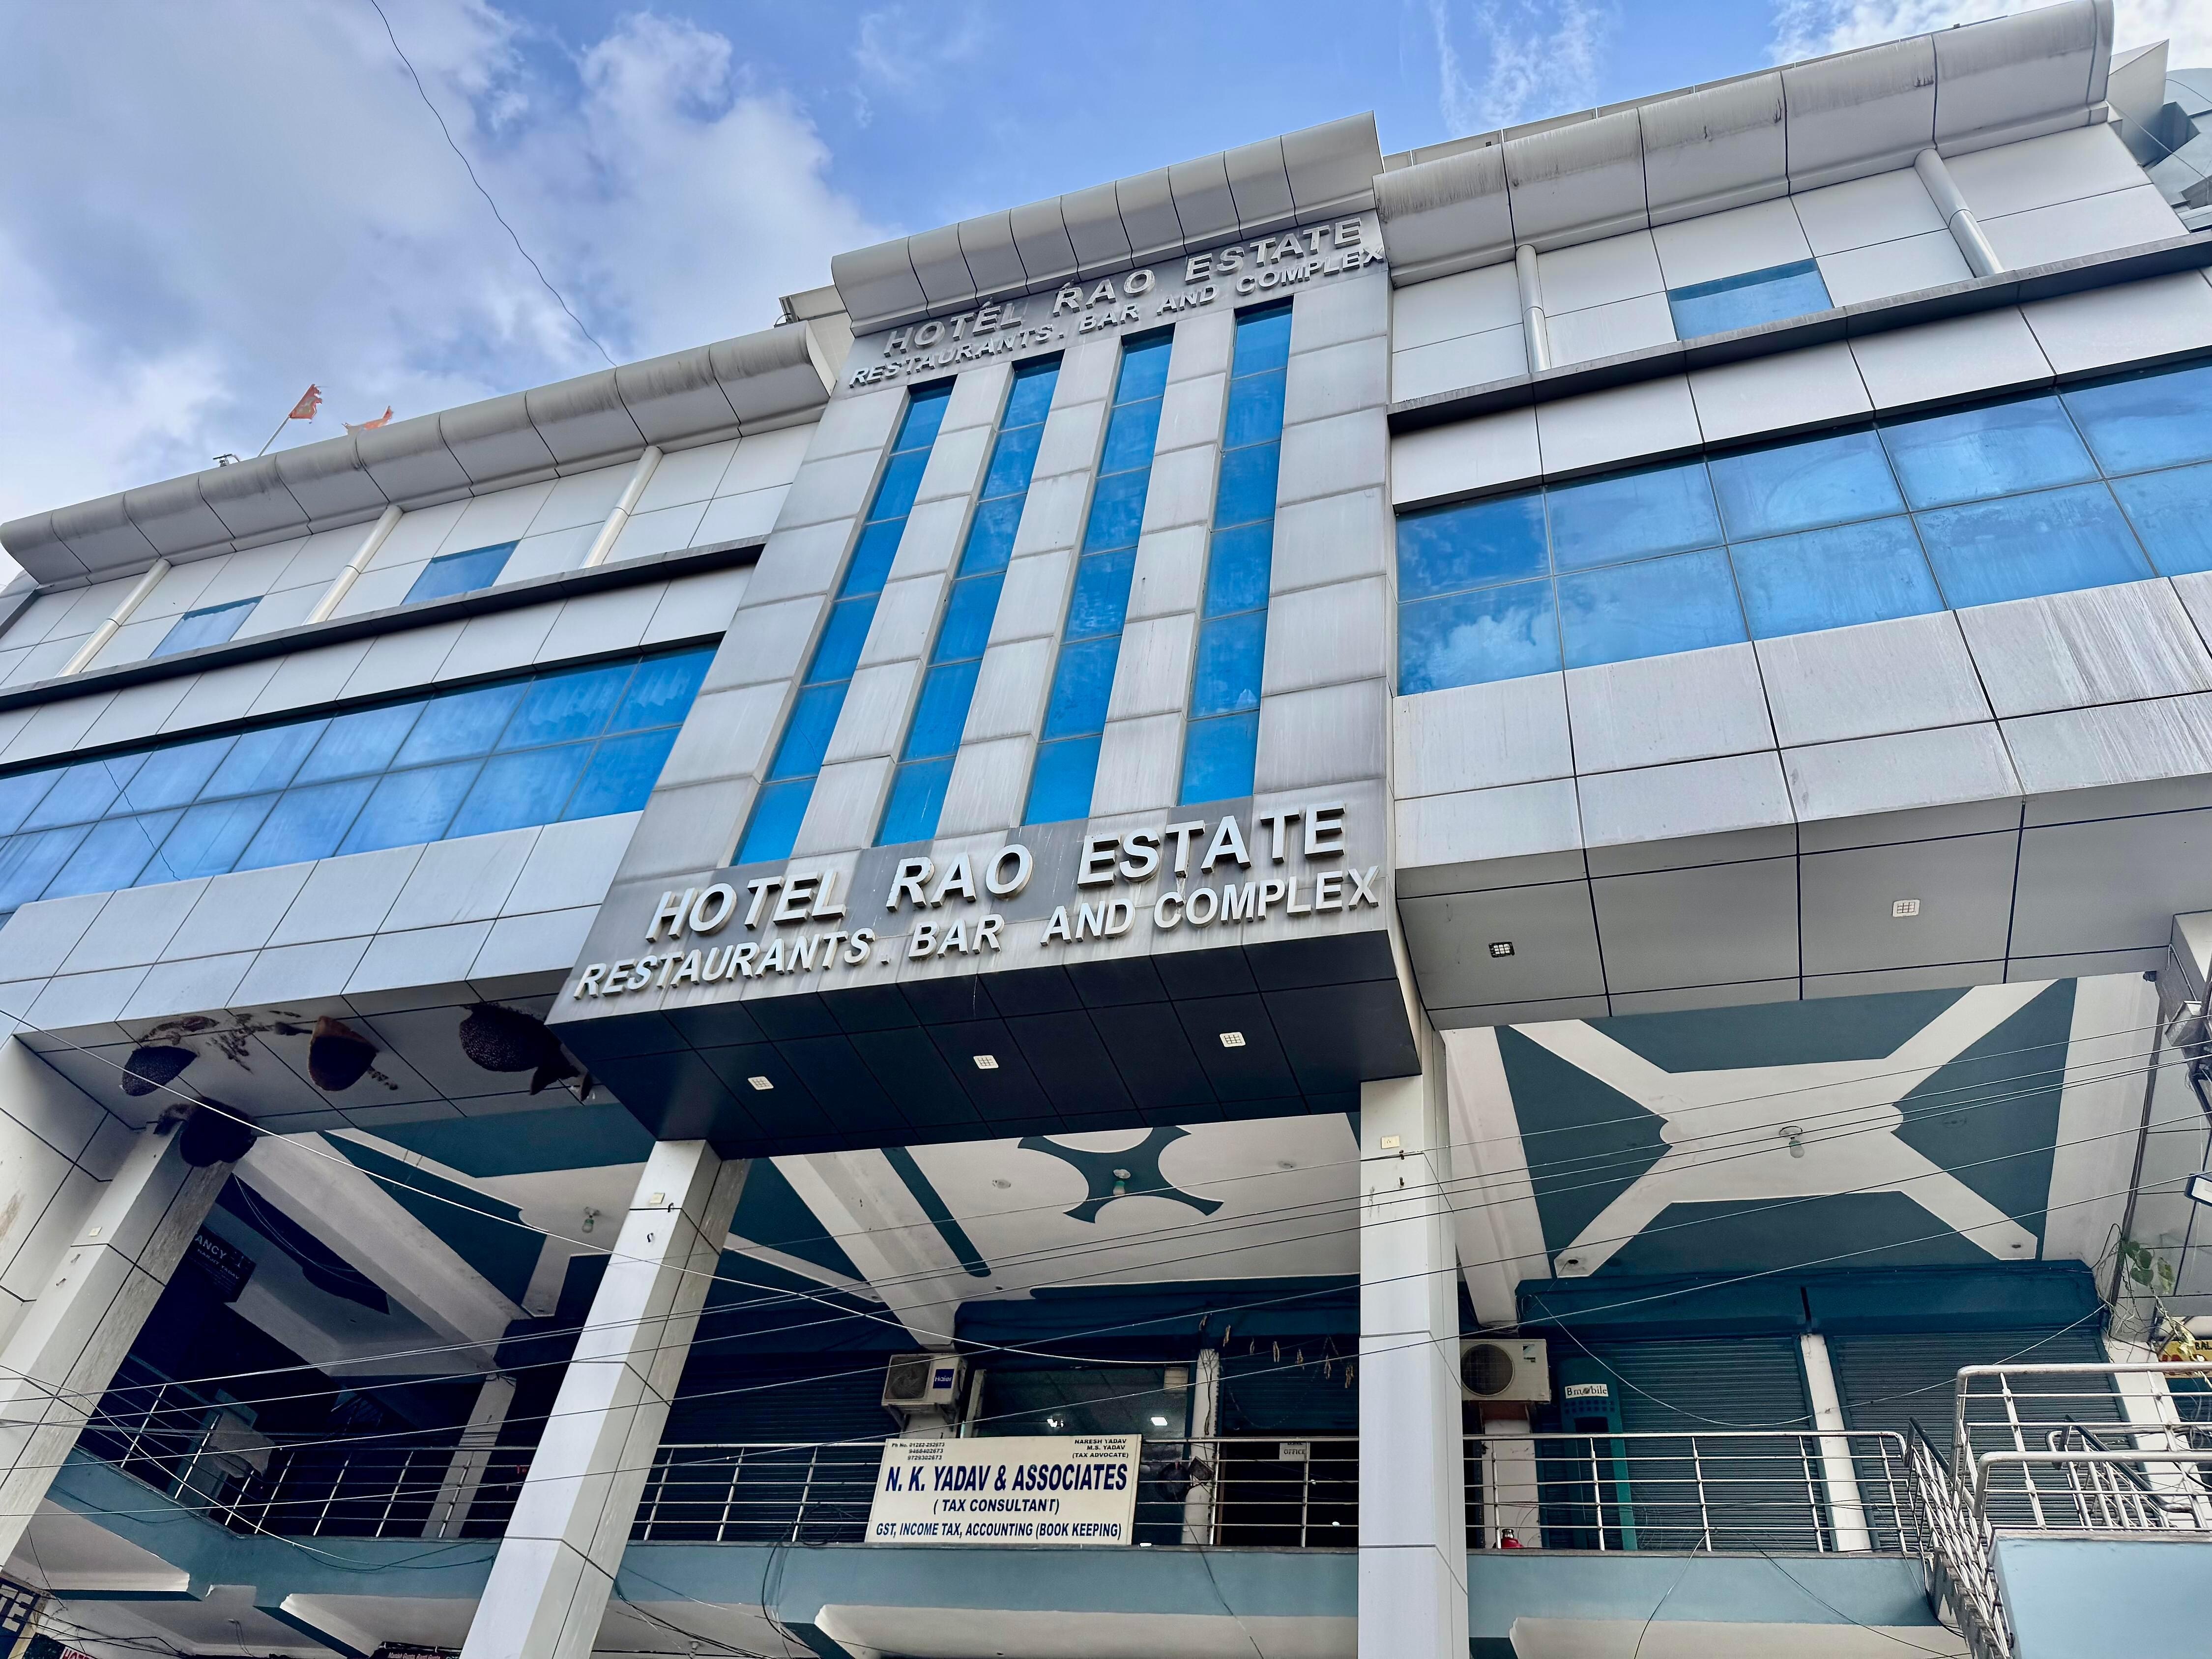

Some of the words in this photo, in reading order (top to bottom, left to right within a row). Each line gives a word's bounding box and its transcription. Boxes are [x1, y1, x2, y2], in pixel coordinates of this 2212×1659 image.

[883, 303, 1022, 357] HOTEL
[1052, 269, 1156, 317] RAO
[1185, 217, 1362, 284] ESTATE
[1079, 303, 1139, 334] BAR
[1157, 284, 1219, 316] AND
[1235, 247, 1384, 295] COMPLEX
[645, 869, 847, 943] HOTEL
[885, 844, 1033, 912] RAO
[1077, 800, 1346, 889] ESTATE
[908, 913, 1005, 962] BAR
[1040, 898, 1135, 947] AND
[1154, 865, 1379, 931] COMPLEX
[885, 1466, 902, 1491] N.
[908, 1466, 925, 1491] K.
[934, 1465, 991, 1491] YADAV
[994, 1464, 1006, 1491] &
[1012, 1463, 1128, 1491] ASSOCIATES
[970, 1498, 1060, 1515] CONSULTANT)
[876, 1523, 897, 1538] GST,
[900, 1523, 939, 1536] INCOME
[942, 1523, 962, 1538] TAX,
[965, 1522, 1033, 1536] ACCOUNTING
[1036, 1522, 1069, 1540] (BOOK
[1072, 1523, 1121, 1540] KEEPING)
